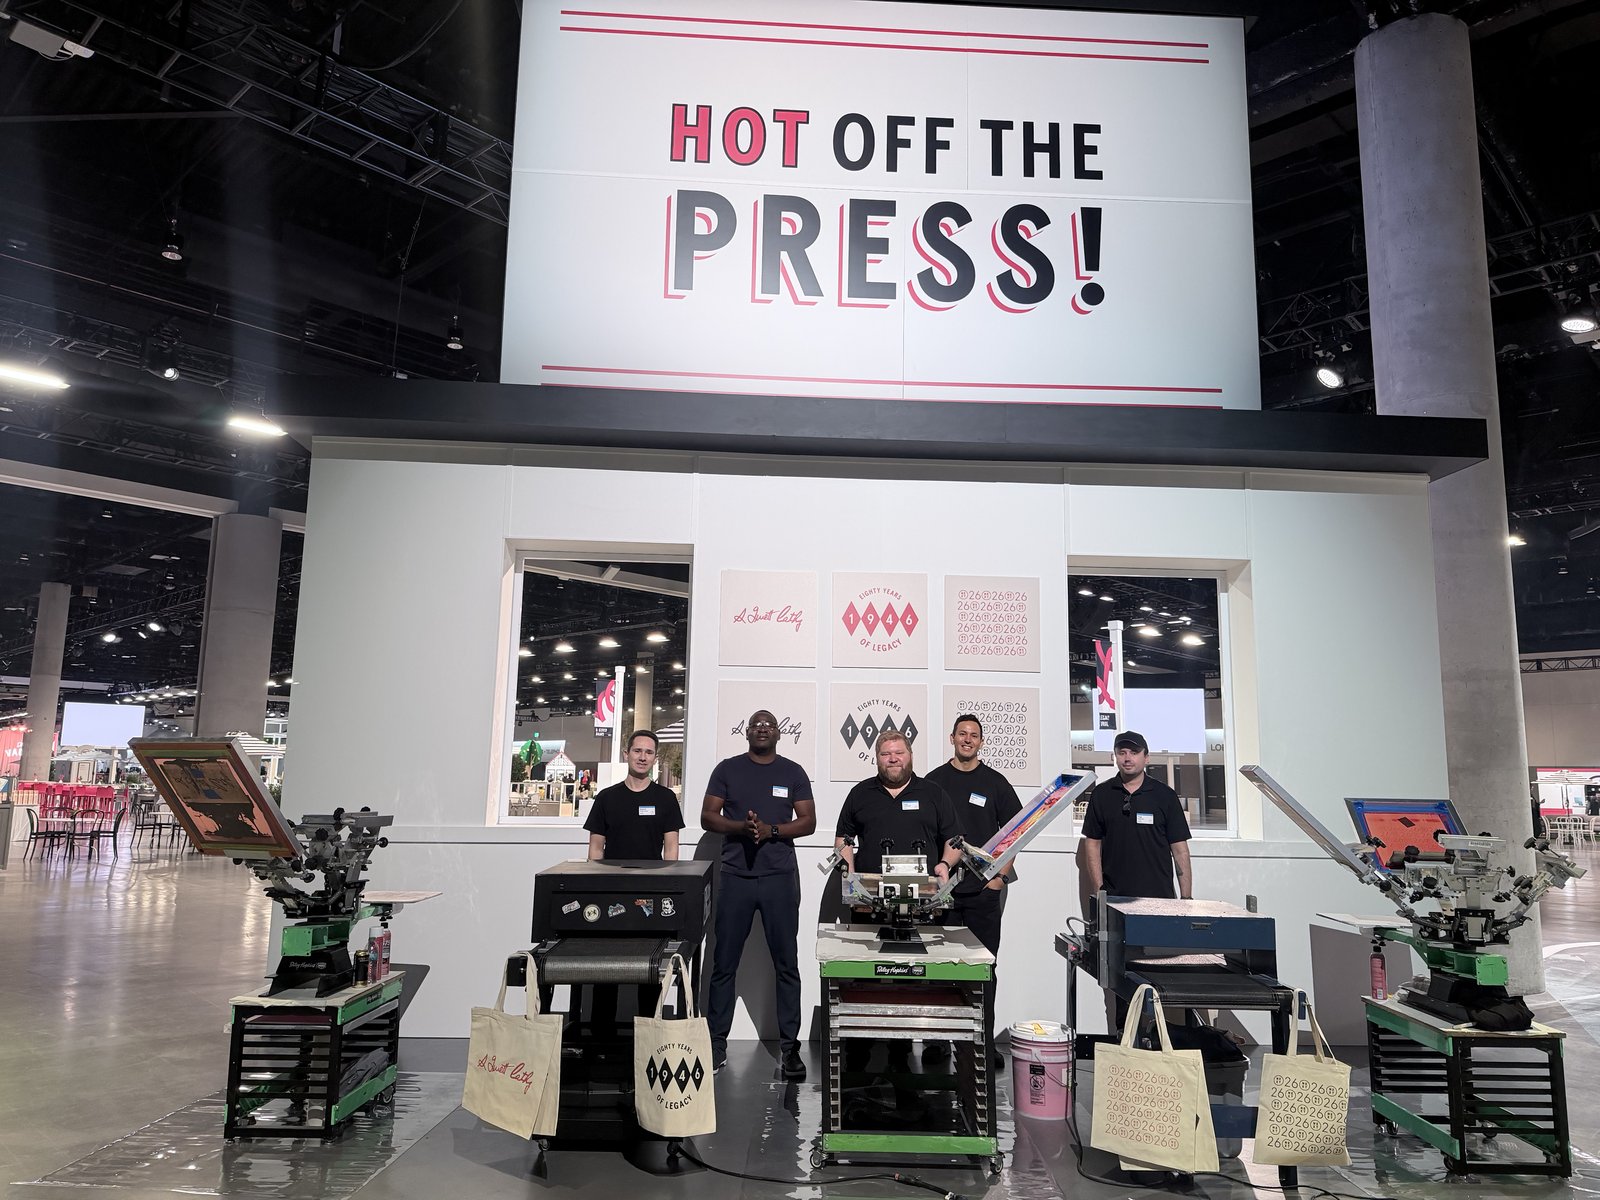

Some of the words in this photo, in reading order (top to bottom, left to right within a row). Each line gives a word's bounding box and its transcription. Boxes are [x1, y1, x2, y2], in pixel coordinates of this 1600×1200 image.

[669, 103, 810, 169] HOT
[832, 112, 955, 174] OFF
[980, 119, 1104, 181] THE
[664, 189, 1106, 315] PRESS!
[859, 588, 880, 600] EIGHTY
[883, 588, 902, 600] YEARS
[860, 638, 871, 648] OF
[873, 638, 902, 651] LEGACY
[857, 699, 879, 711] EIGHTY
[882, 700, 901, 712] YEARS
[858, 752, 869, 761] OF
[657, 1043, 675, 1054] EIGHTY
[678, 1043, 692, 1054] YEARS
[1108, 1076, 1120, 1088] 26
[1131, 1082, 1144, 1093] 26
[1157, 1086, 1169, 1098] 26
[1120, 1067, 1132, 1079] 26
[1144, 1072, 1157, 1084] 26
[1170, 1077, 1183, 1088] 26
[1285, 1077, 1298, 1088] 26
[1311, 1082, 1325, 1094] 26
[657, 1094, 664, 1104] OF
[665, 1094, 692, 1109] LEGACY
[1119, 1091, 1131, 1103] 26
[1143, 1096, 1156, 1108] 26
[1169, 1101, 1182, 1113] 26
[1271, 1087, 1284, 1098] 26
[1297, 1092, 1310, 1103] 26
[1324, 1098, 1338, 1109] 26
[1106, 1100, 1119, 1111] 26
[1130, 1106, 1143, 1117] 26
[1155, 1111, 1168, 1122] 26
[1283, 1101, 1296, 1113] 26
[1310, 1107, 1323, 1119] 26
[1118, 1115, 1130, 1127] 26
[1142, 1121, 1155, 1132] 26
[1168, 1125, 1180, 1137] 26
[1269, 1111, 1282, 1123] 26
[1295, 1116, 1309, 1128] 26
[1322, 1122, 1336, 1134] 26
[1105, 1124, 1117, 1135] 26
[1129, 1130, 1142, 1142] 26
[1154, 1135, 1167, 1147] 26
[1281, 1126, 1295, 1138] 26
[1307, 1132, 1321, 1143] 26
[1268, 1136, 1281, 1148] 26
[1294, 1142, 1307, 1152] 26
[1319, 1146, 1332, 1154] 26
